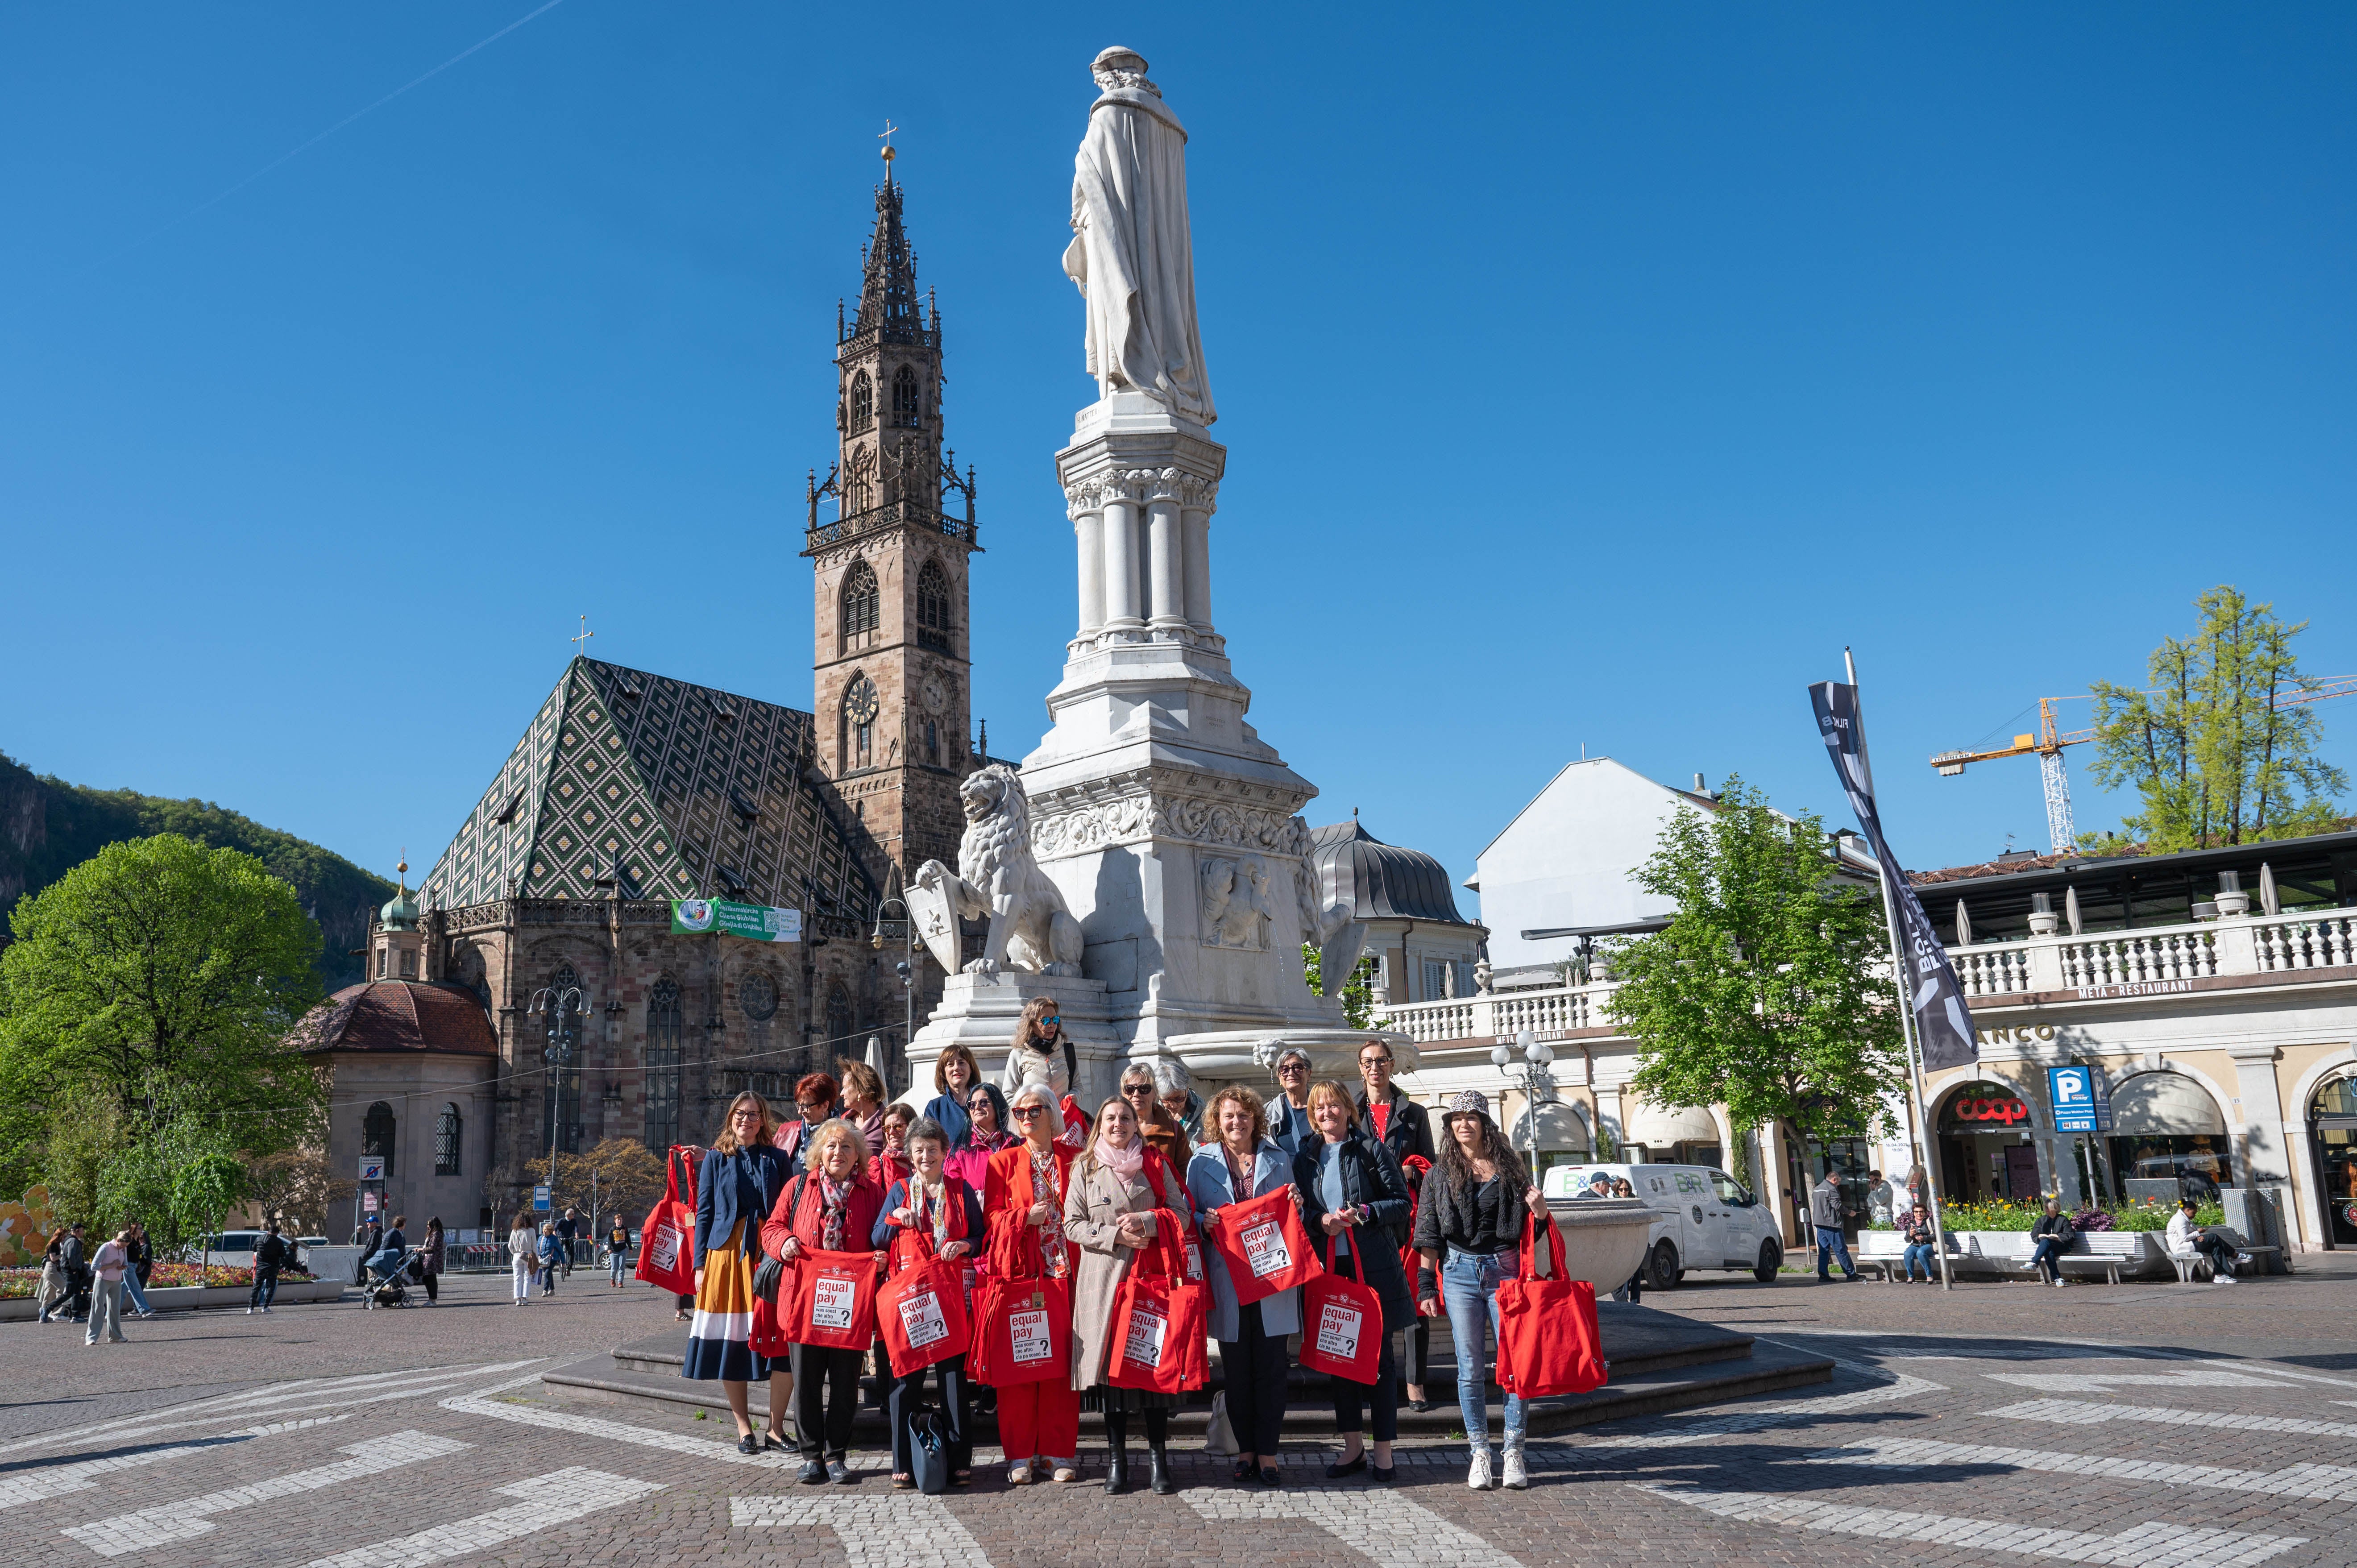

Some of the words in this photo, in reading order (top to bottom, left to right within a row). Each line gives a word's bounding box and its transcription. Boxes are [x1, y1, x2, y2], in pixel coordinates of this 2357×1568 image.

[2078, 987, 2107, 999] META
[2118, 980, 2192, 996] RESTAURANT
[1496, 1035, 1514, 1045] META
[1534, 1030, 1565, 1042] TAURANT
[2057, 1077, 2082, 1102] P
[1956, 1098, 2028, 1125] coop
[1564, 1174, 1592, 1192] B&
[1674, 1173, 1705, 1193] B&R
[1681, 1193, 1708, 1202] SERVICE
[657, 1227, 679, 1241] equal
[1244, 1224, 1275, 1243] equal
[1247, 1240, 1267, 1257] pay
[666, 1255, 675, 1268] ?
[1277, 1249, 1286, 1265] ?
[964, 1272, 975, 1283] equ
[818, 1281, 848, 1293] equal
[817, 1294, 837, 1306] pay
[901, 1294, 932, 1314] equal
[841, 1310, 850, 1326] ?
[905, 1311, 924, 1328] pay
[1012, 1312, 1042, 1327] equal
[1131, 1312, 1161, 1329] equal
[1324, 1307, 1355, 1323] equal
[918, 1324, 930, 1332] sonst
[934, 1320, 943, 1336] ?
[1013, 1327, 1032, 1340] pay
[1128, 1325, 1148, 1339] pay
[1322, 1319, 1342, 1333] pay
[1040, 1340, 1049, 1356] ?
[1150, 1347, 1159, 1364] ?
[1346, 1340, 1355, 1355] ?
